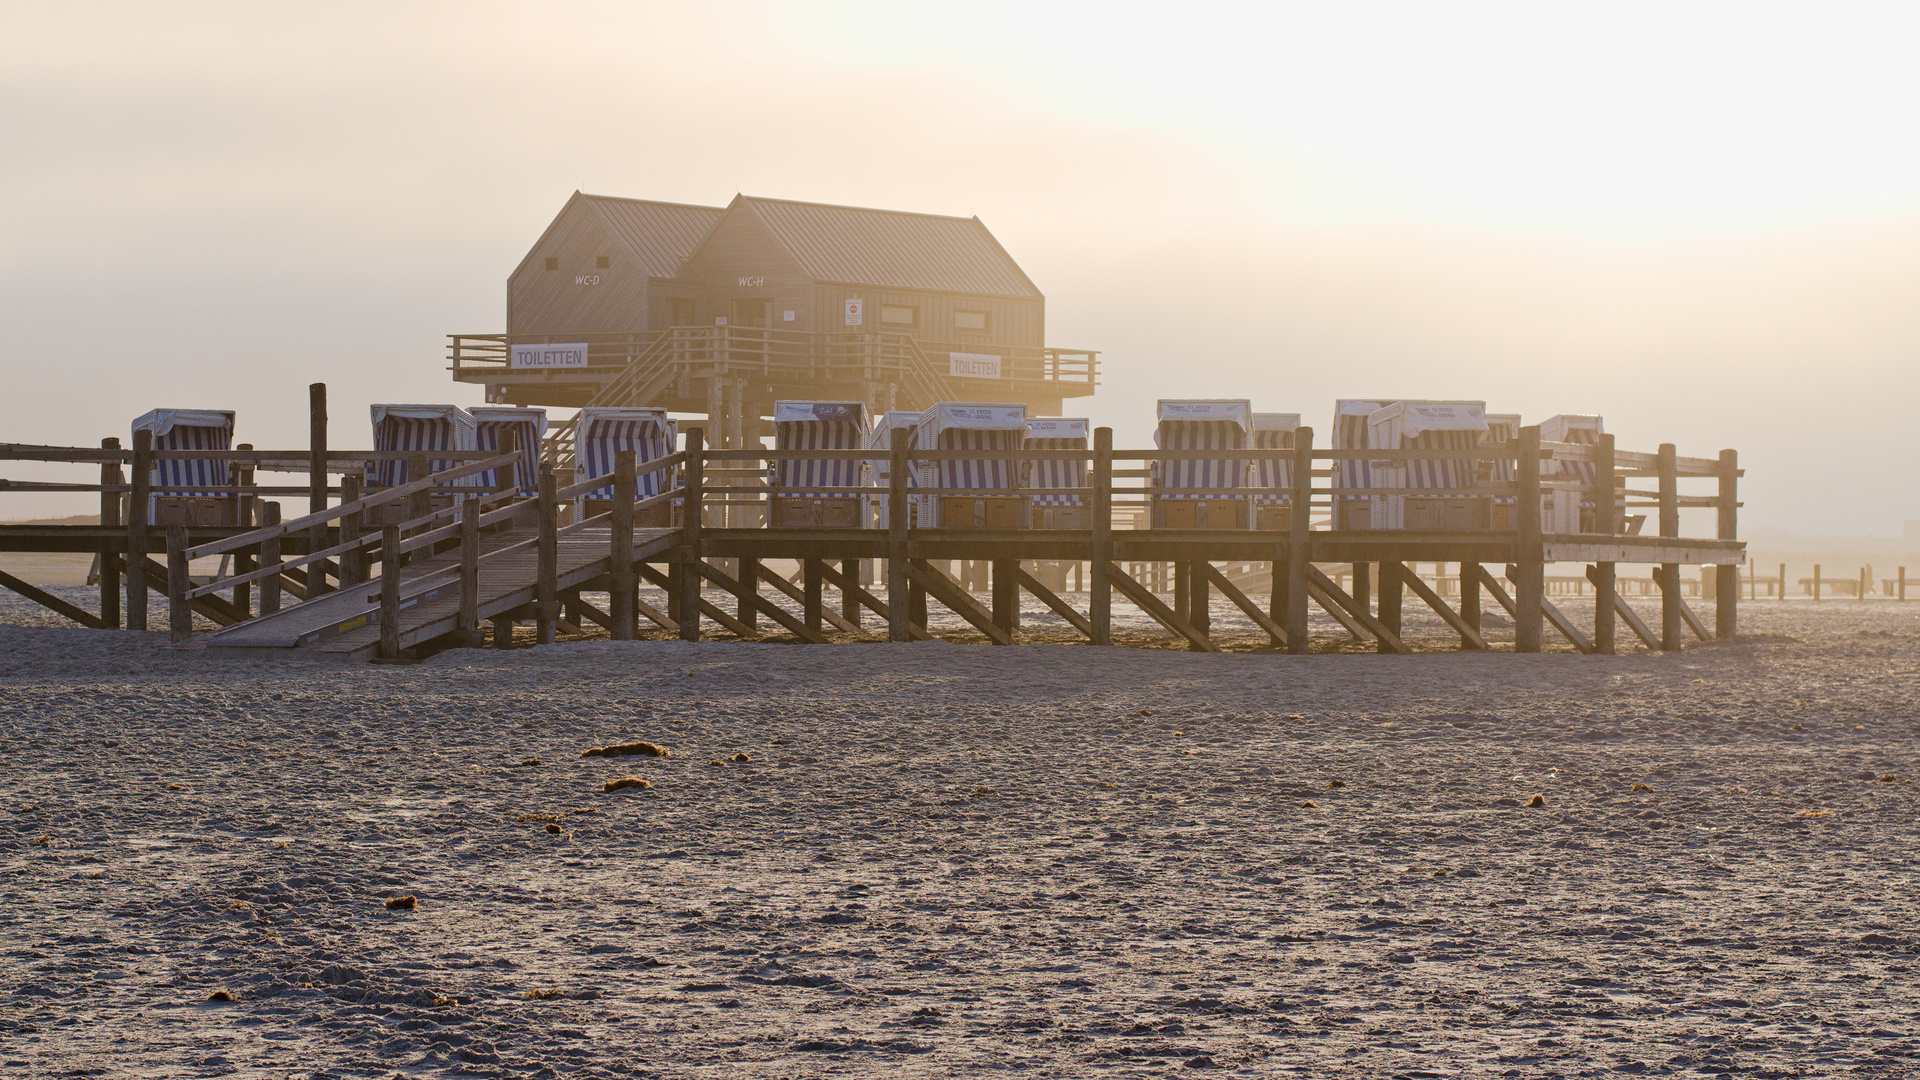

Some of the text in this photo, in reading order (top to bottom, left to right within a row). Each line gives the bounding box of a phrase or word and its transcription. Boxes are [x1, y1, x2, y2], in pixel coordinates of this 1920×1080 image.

[575, 275, 600, 286] WC-D
[738, 276, 764, 287] WC-H
[517, 350, 582, 365] TOILETTEN
[954, 359, 998, 376] TOILETTEN
